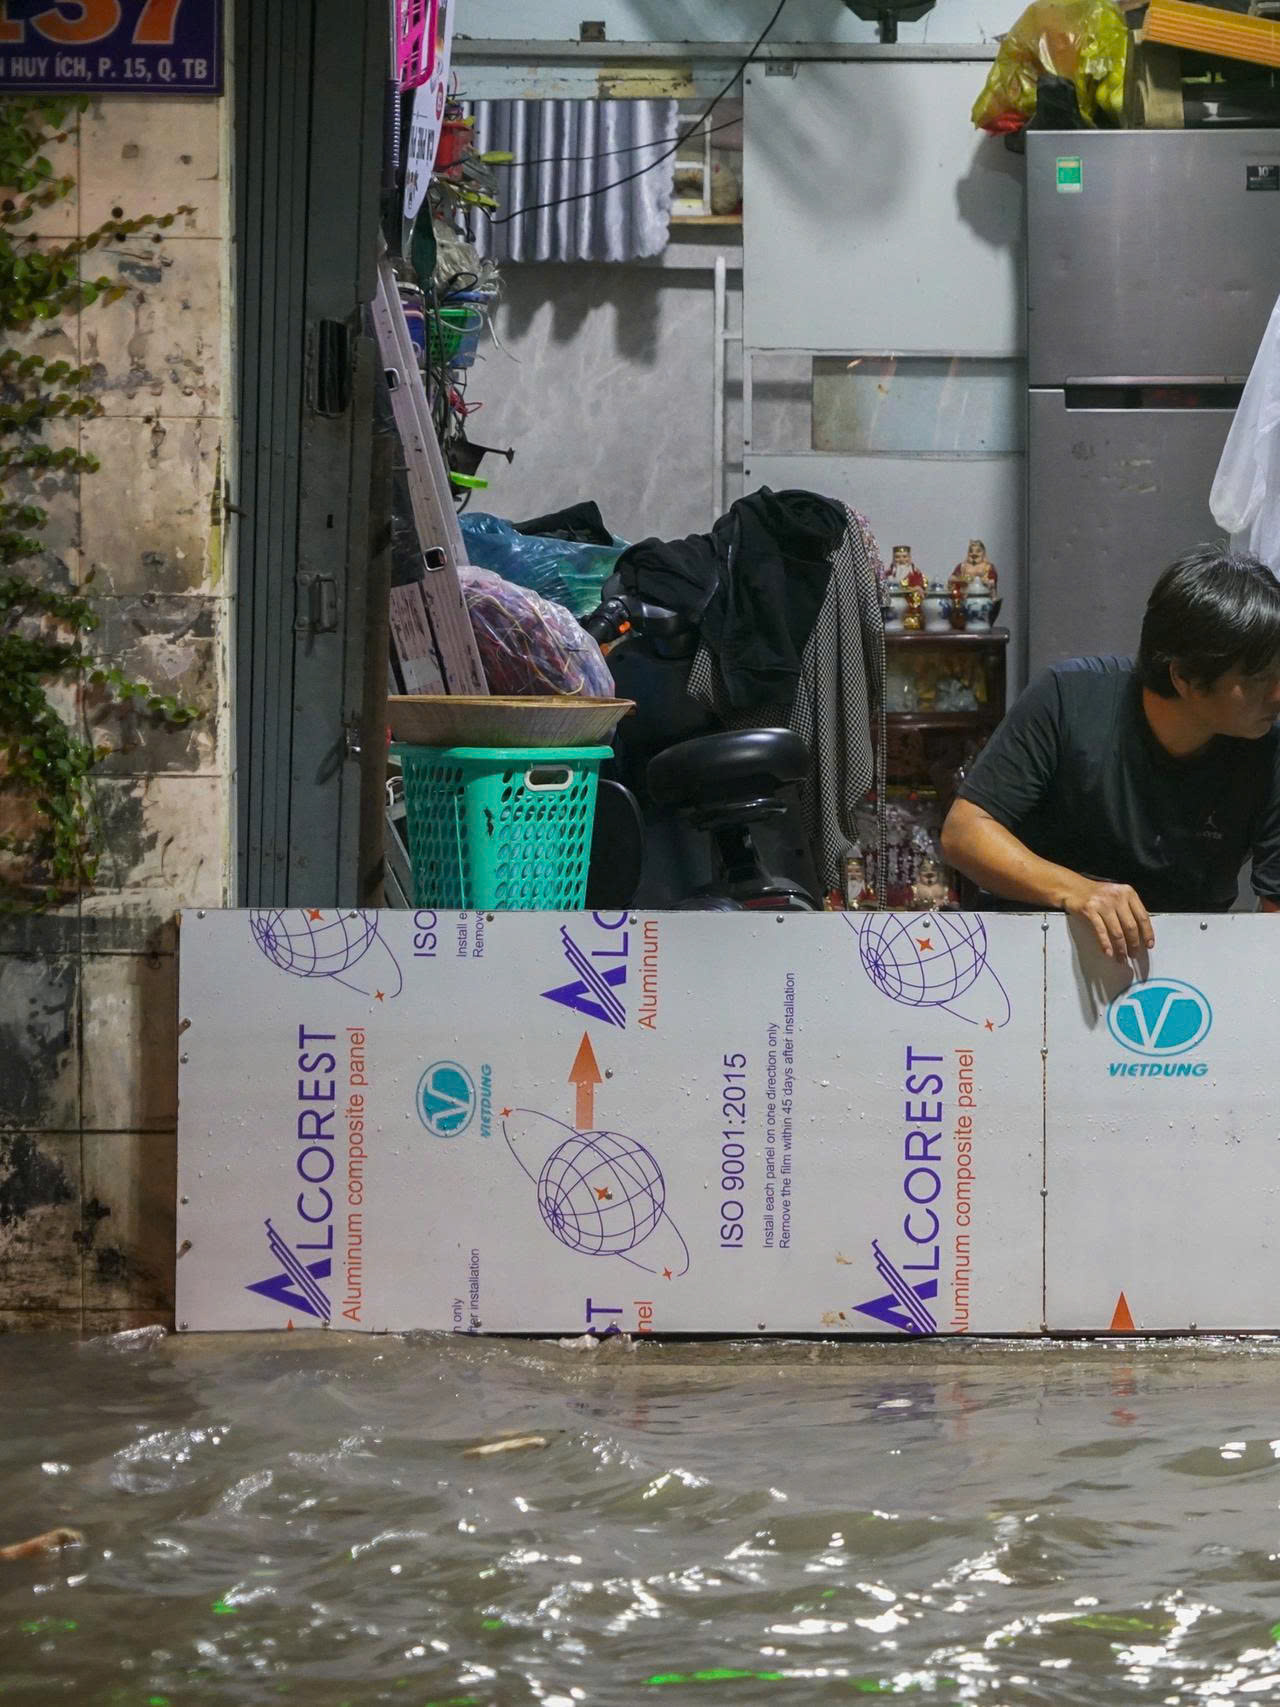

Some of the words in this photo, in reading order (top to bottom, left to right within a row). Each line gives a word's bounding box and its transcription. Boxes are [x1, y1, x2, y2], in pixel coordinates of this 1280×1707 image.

[11, 57, 48, 77] HUY
[55, 52, 92, 80] ÍCH,
[98, 58, 116, 77] P.
[124, 58, 152, 82] 15,
[158, 58, 176, 81] Q.
[182, 59, 208, 79] TB
[413, 910, 437, 956] ISO
[456, 924, 467, 957] Install
[638, 921, 658, 1029] Aluminum
[782, 973, 795, 1034] installation
[767, 1022, 780, 1046] only
[346, 1028, 368, 1085] panel
[782, 1038, 793, 1064] after
[766, 1050, 776, 1099] direction
[782, 1067, 795, 1096] days
[955, 1049, 976, 1107] panel
[1107, 1063, 1208, 1076] VIETDUNG
[480, 1064, 492, 1137] VIETDUNG
[767, 1103, 776, 1125] one
[781, 1099, 792, 1114] 45
[721, 1053, 746, 1190] 9001:2015
[767, 1129, 775, 1143] on
[781, 1117, 792, 1150] within
[345, 1094, 367, 1205] composite
[765, 1147, 777, 1178] panel
[780, 1154, 791, 1174] film
[245, 1024, 336, 1322] ALCOREST
[780, 1178, 791, 1197] the
[953, 1116, 976, 1226] composite
[764, 1183, 774, 1211] each
[852, 1046, 944, 1332] ALCOREST
[720, 1200, 743, 1247] ISO
[763, 1215, 773, 1247] Install
[779, 1200, 790, 1248] Remove
[342, 1213, 362, 1321] Aluminum
[469, 1249, 480, 1309] installation
[452, 1298, 464, 1322] only
[634, 1301, 653, 1332] nel
